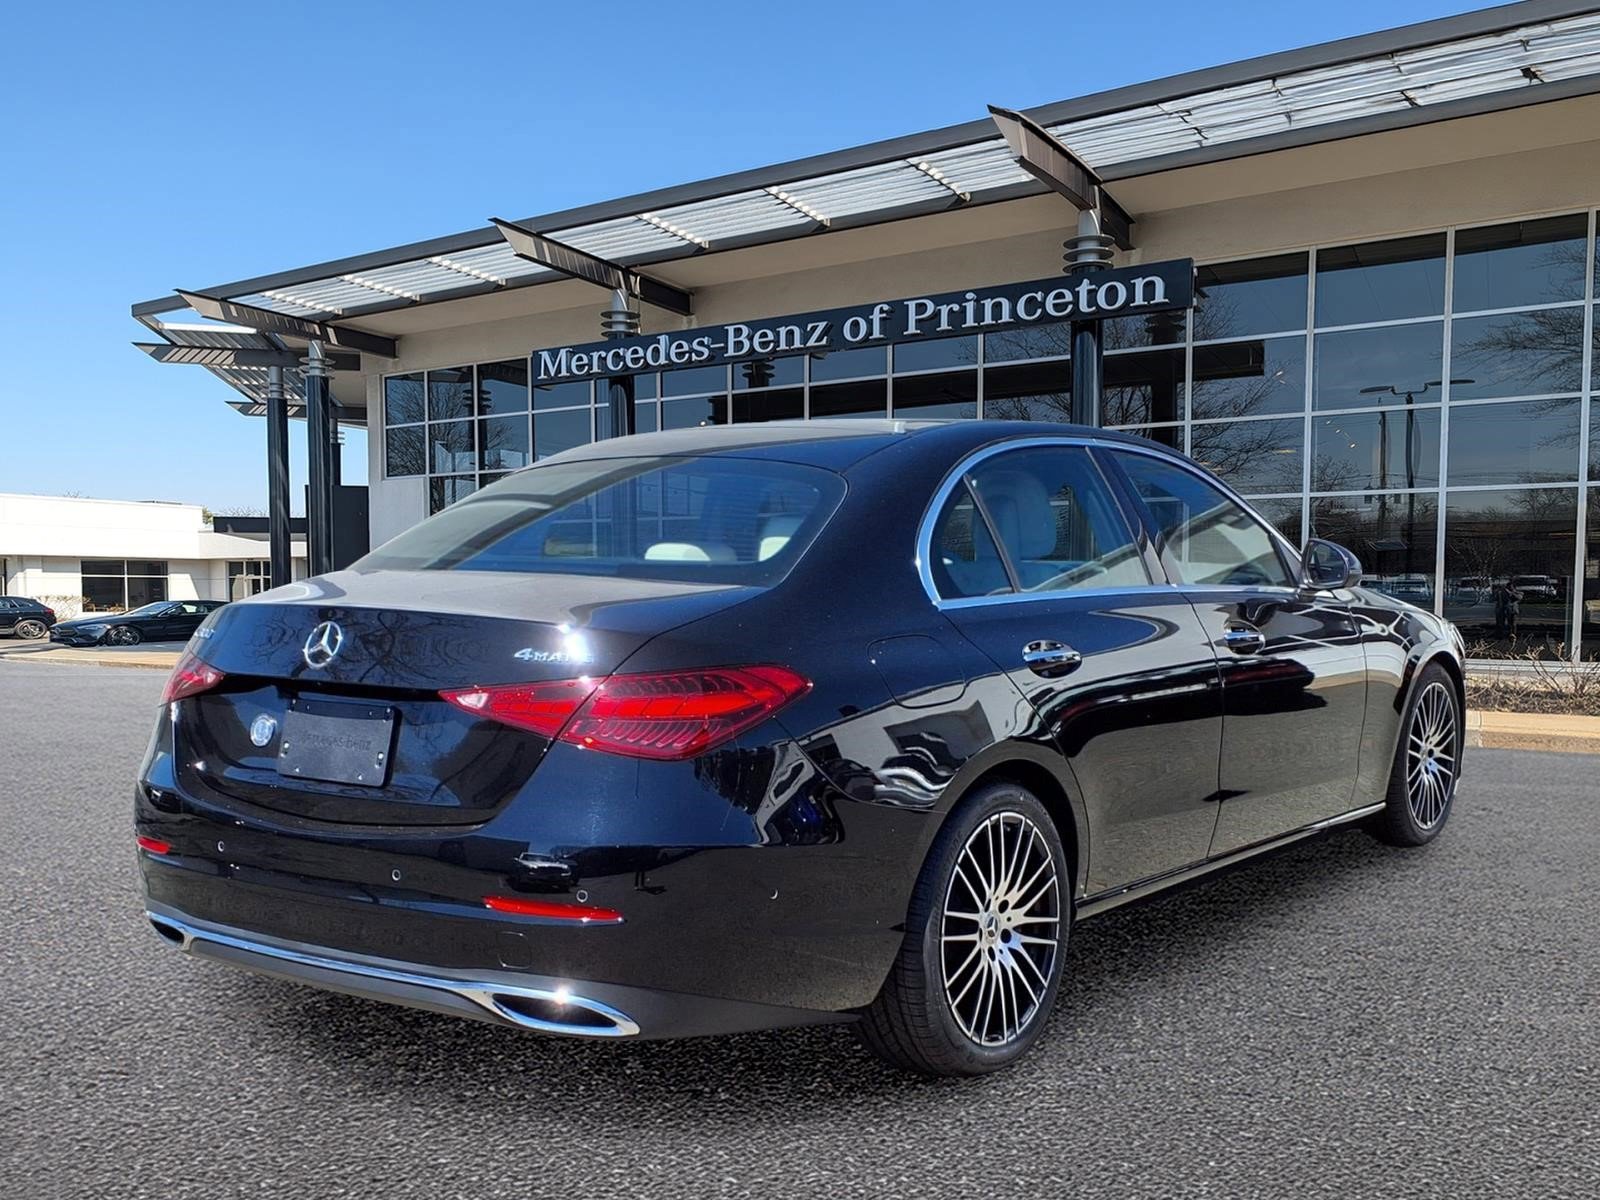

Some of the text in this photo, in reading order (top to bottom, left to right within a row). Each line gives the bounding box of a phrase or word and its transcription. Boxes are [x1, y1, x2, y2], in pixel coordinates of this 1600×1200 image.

[537, 275, 1170, 379] Mercedes-Benz of Princeton
